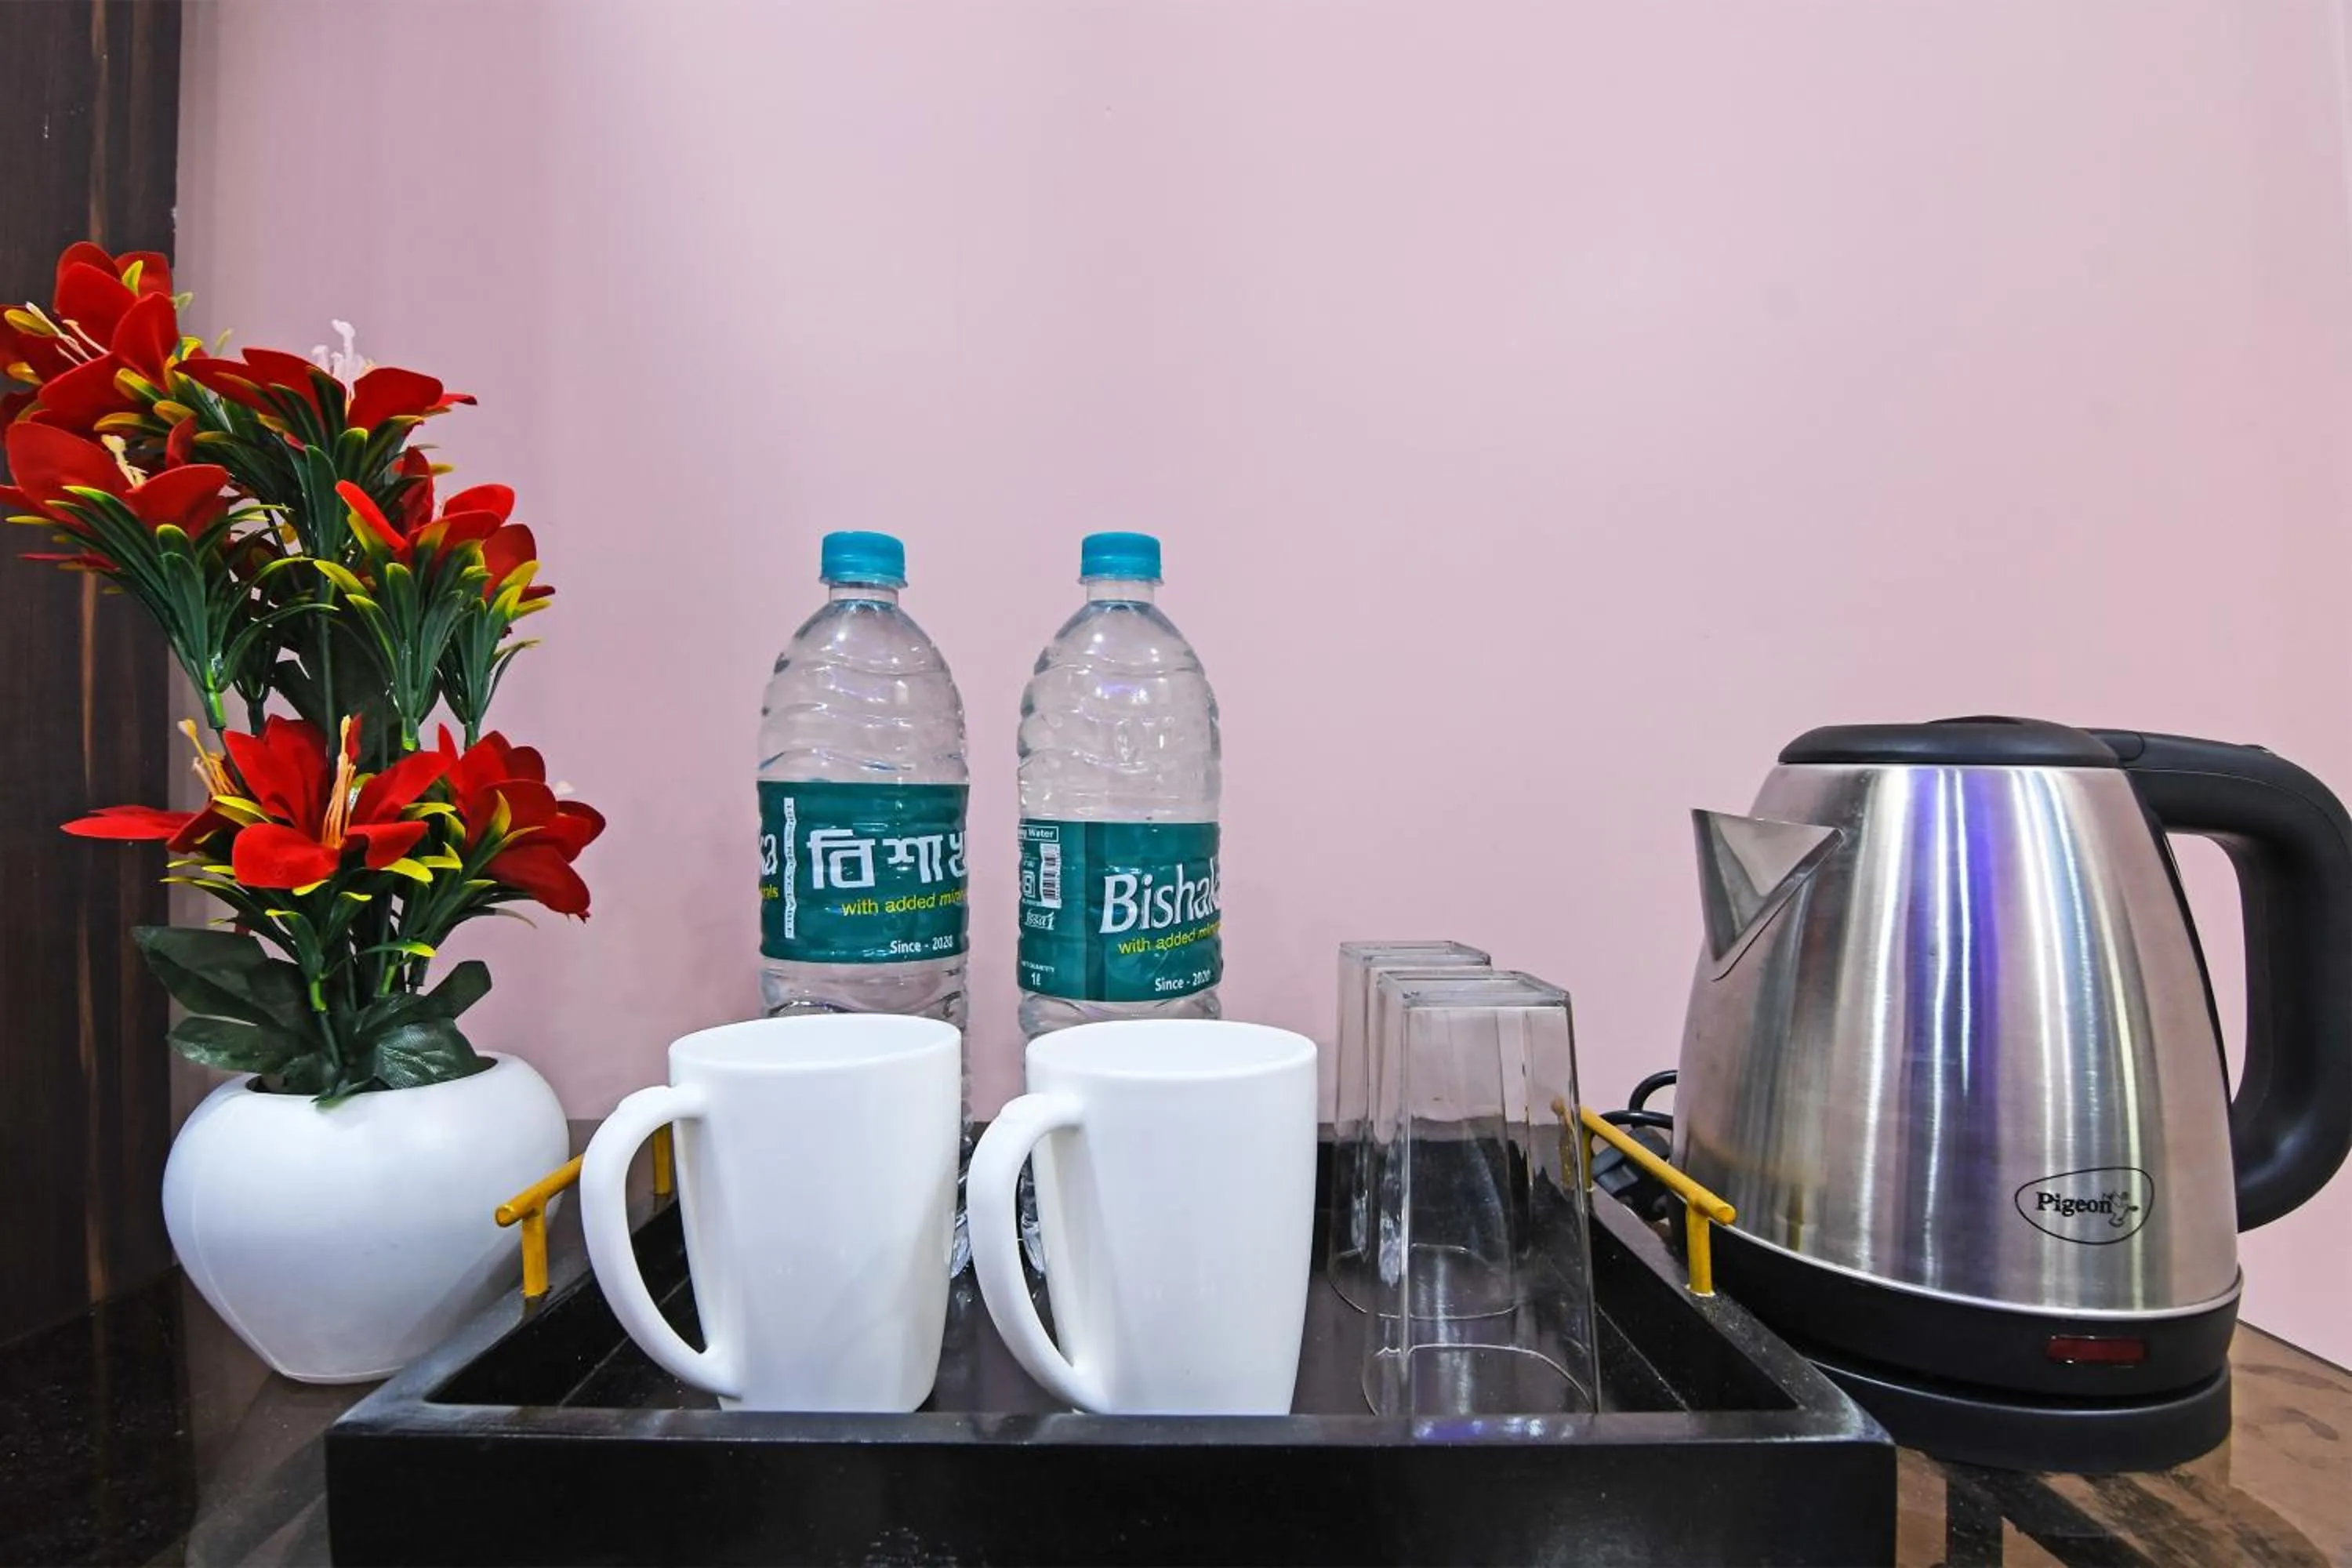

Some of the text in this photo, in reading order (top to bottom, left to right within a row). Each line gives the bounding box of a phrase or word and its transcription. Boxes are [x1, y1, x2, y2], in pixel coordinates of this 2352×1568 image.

[1028, 828, 1054, 838] Water
[842, 898, 879, 916] with
[884, 895, 935, 913] added
[890, 941, 921, 954] Since
[1118, 937, 1151, 954] with
[1156, 928, 1196, 950] added
[1155, 978, 1184, 992] Since
[2036, 1191, 2113, 1217] Pigeon
